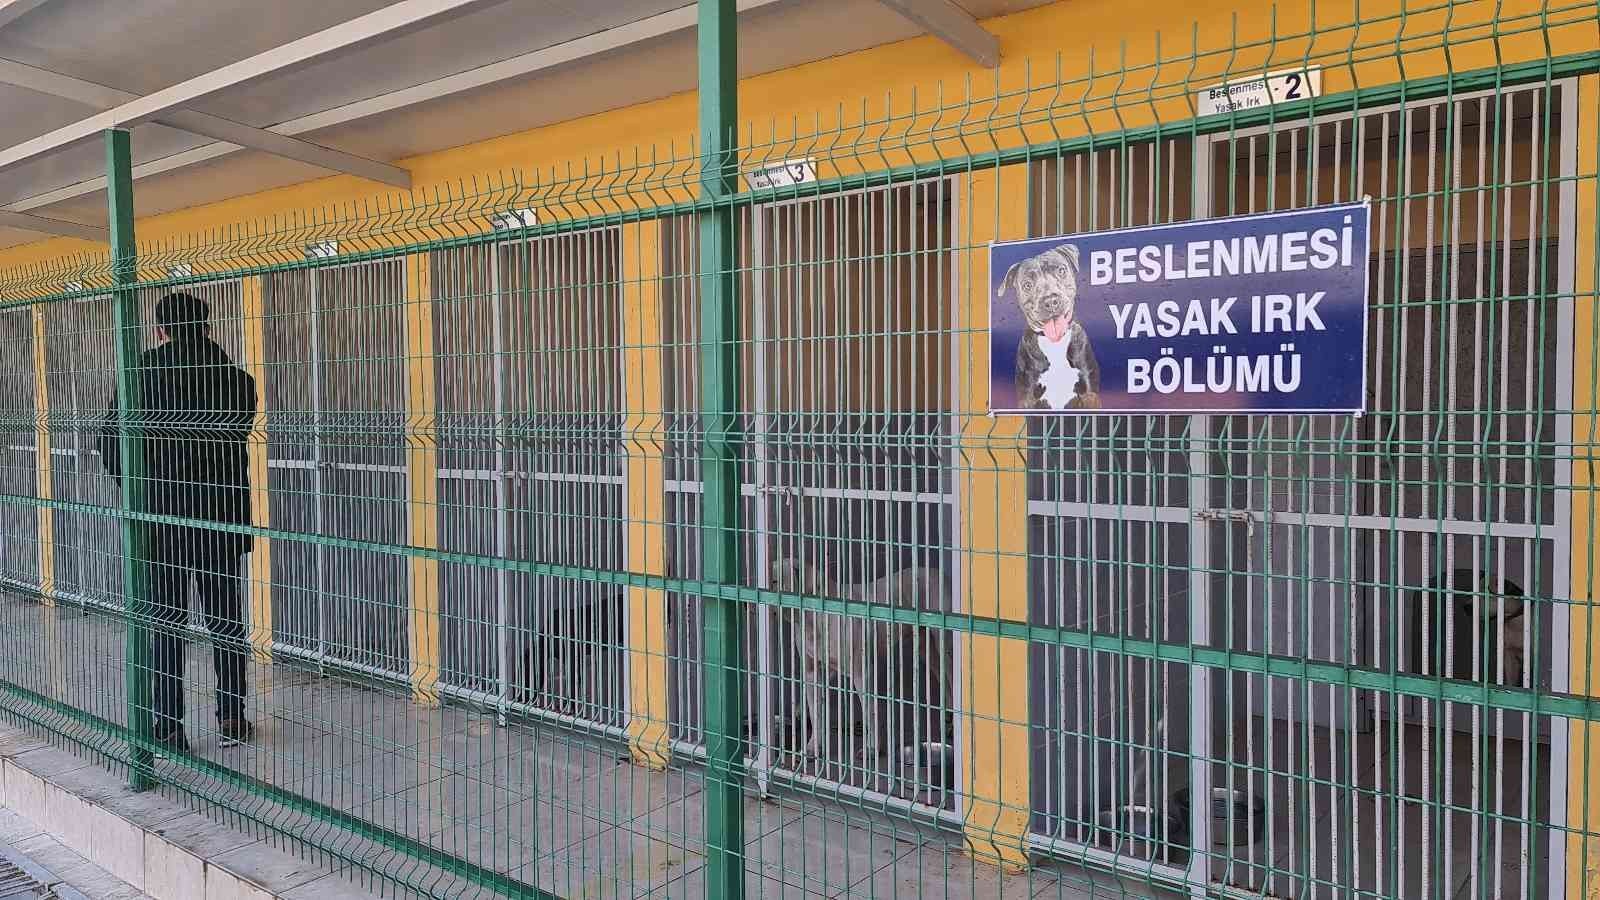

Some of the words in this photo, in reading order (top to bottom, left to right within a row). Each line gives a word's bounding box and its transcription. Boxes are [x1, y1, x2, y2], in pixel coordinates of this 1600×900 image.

[1209, 81, 1264, 100] Besenmes
[1285, 74, 1302, 100] 2
[795, 165, 805, 182] 3
[1090, 214, 1354, 286] BESLENMESİ
[1108, 296, 1238, 339] YASAK
[1251, 291, 1328, 333] IRK
[1127, 343, 1302, 394] BÖLÜMÜ
